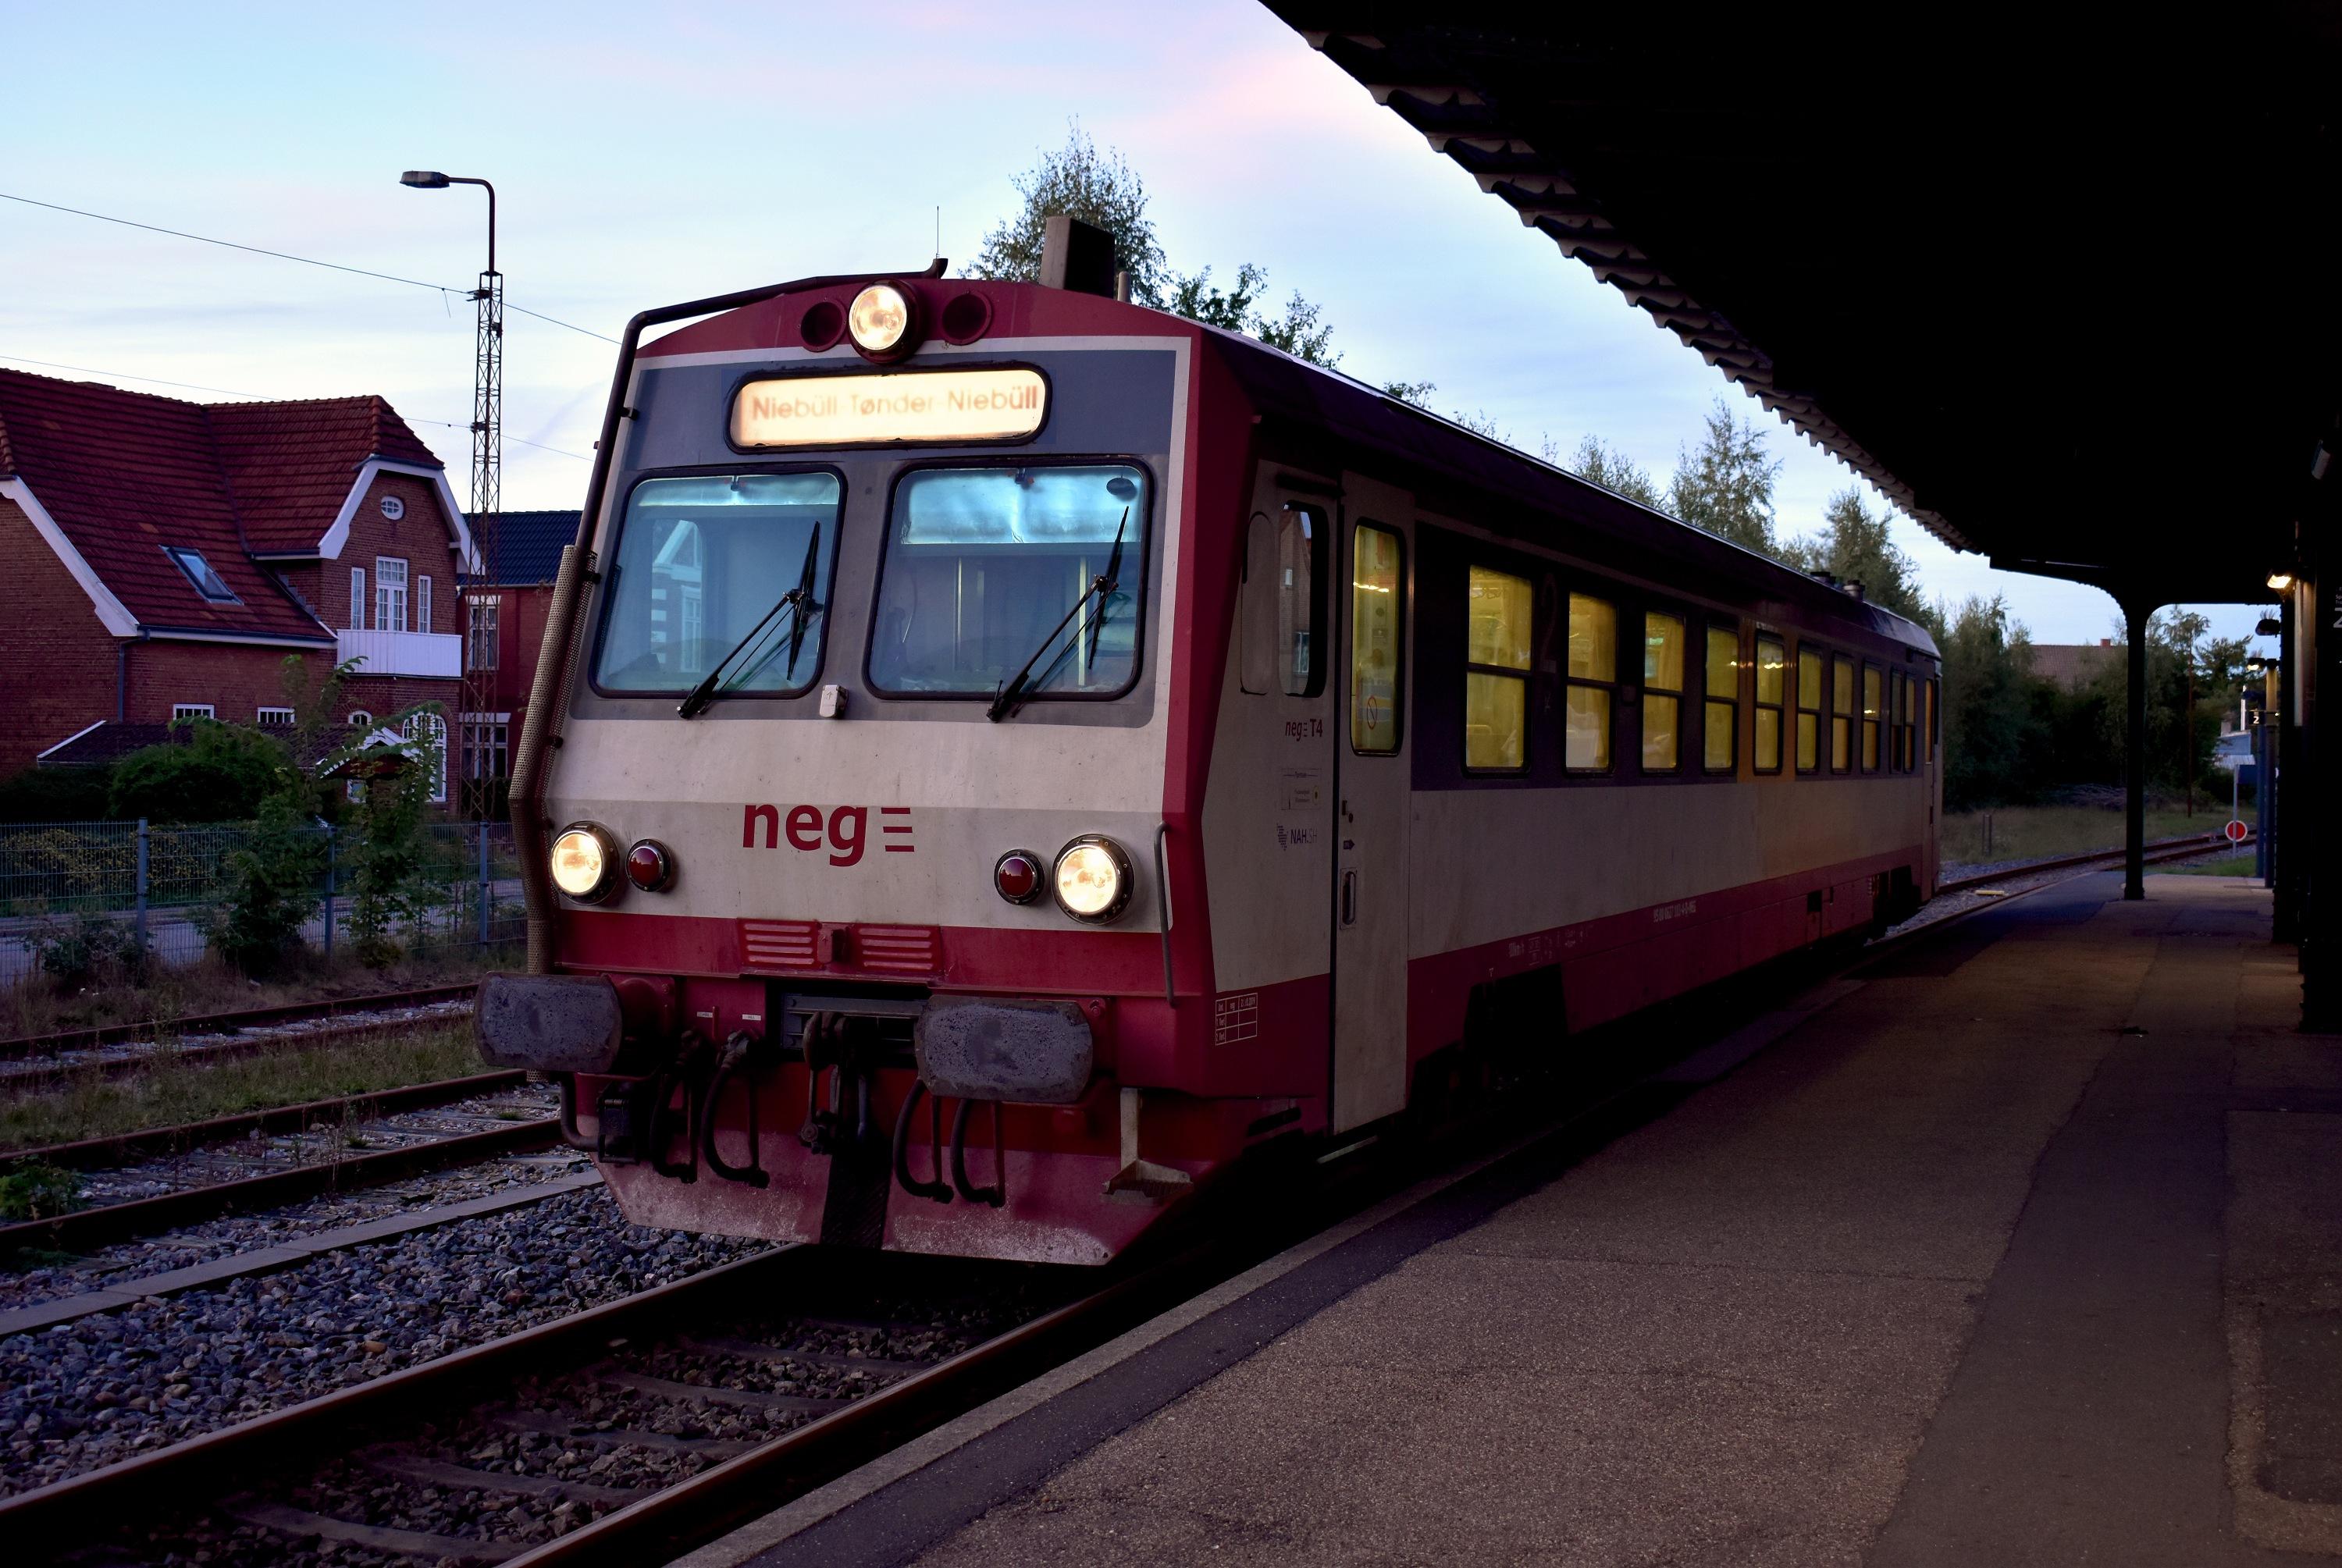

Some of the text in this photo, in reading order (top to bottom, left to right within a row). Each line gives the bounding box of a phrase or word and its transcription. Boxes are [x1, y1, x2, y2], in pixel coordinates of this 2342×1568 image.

[752, 386, 1038, 421] Niebüll Tønder Niebüll
[1310, 719, 1322, 738] T4
[2253, 716, 2259, 724] 2
